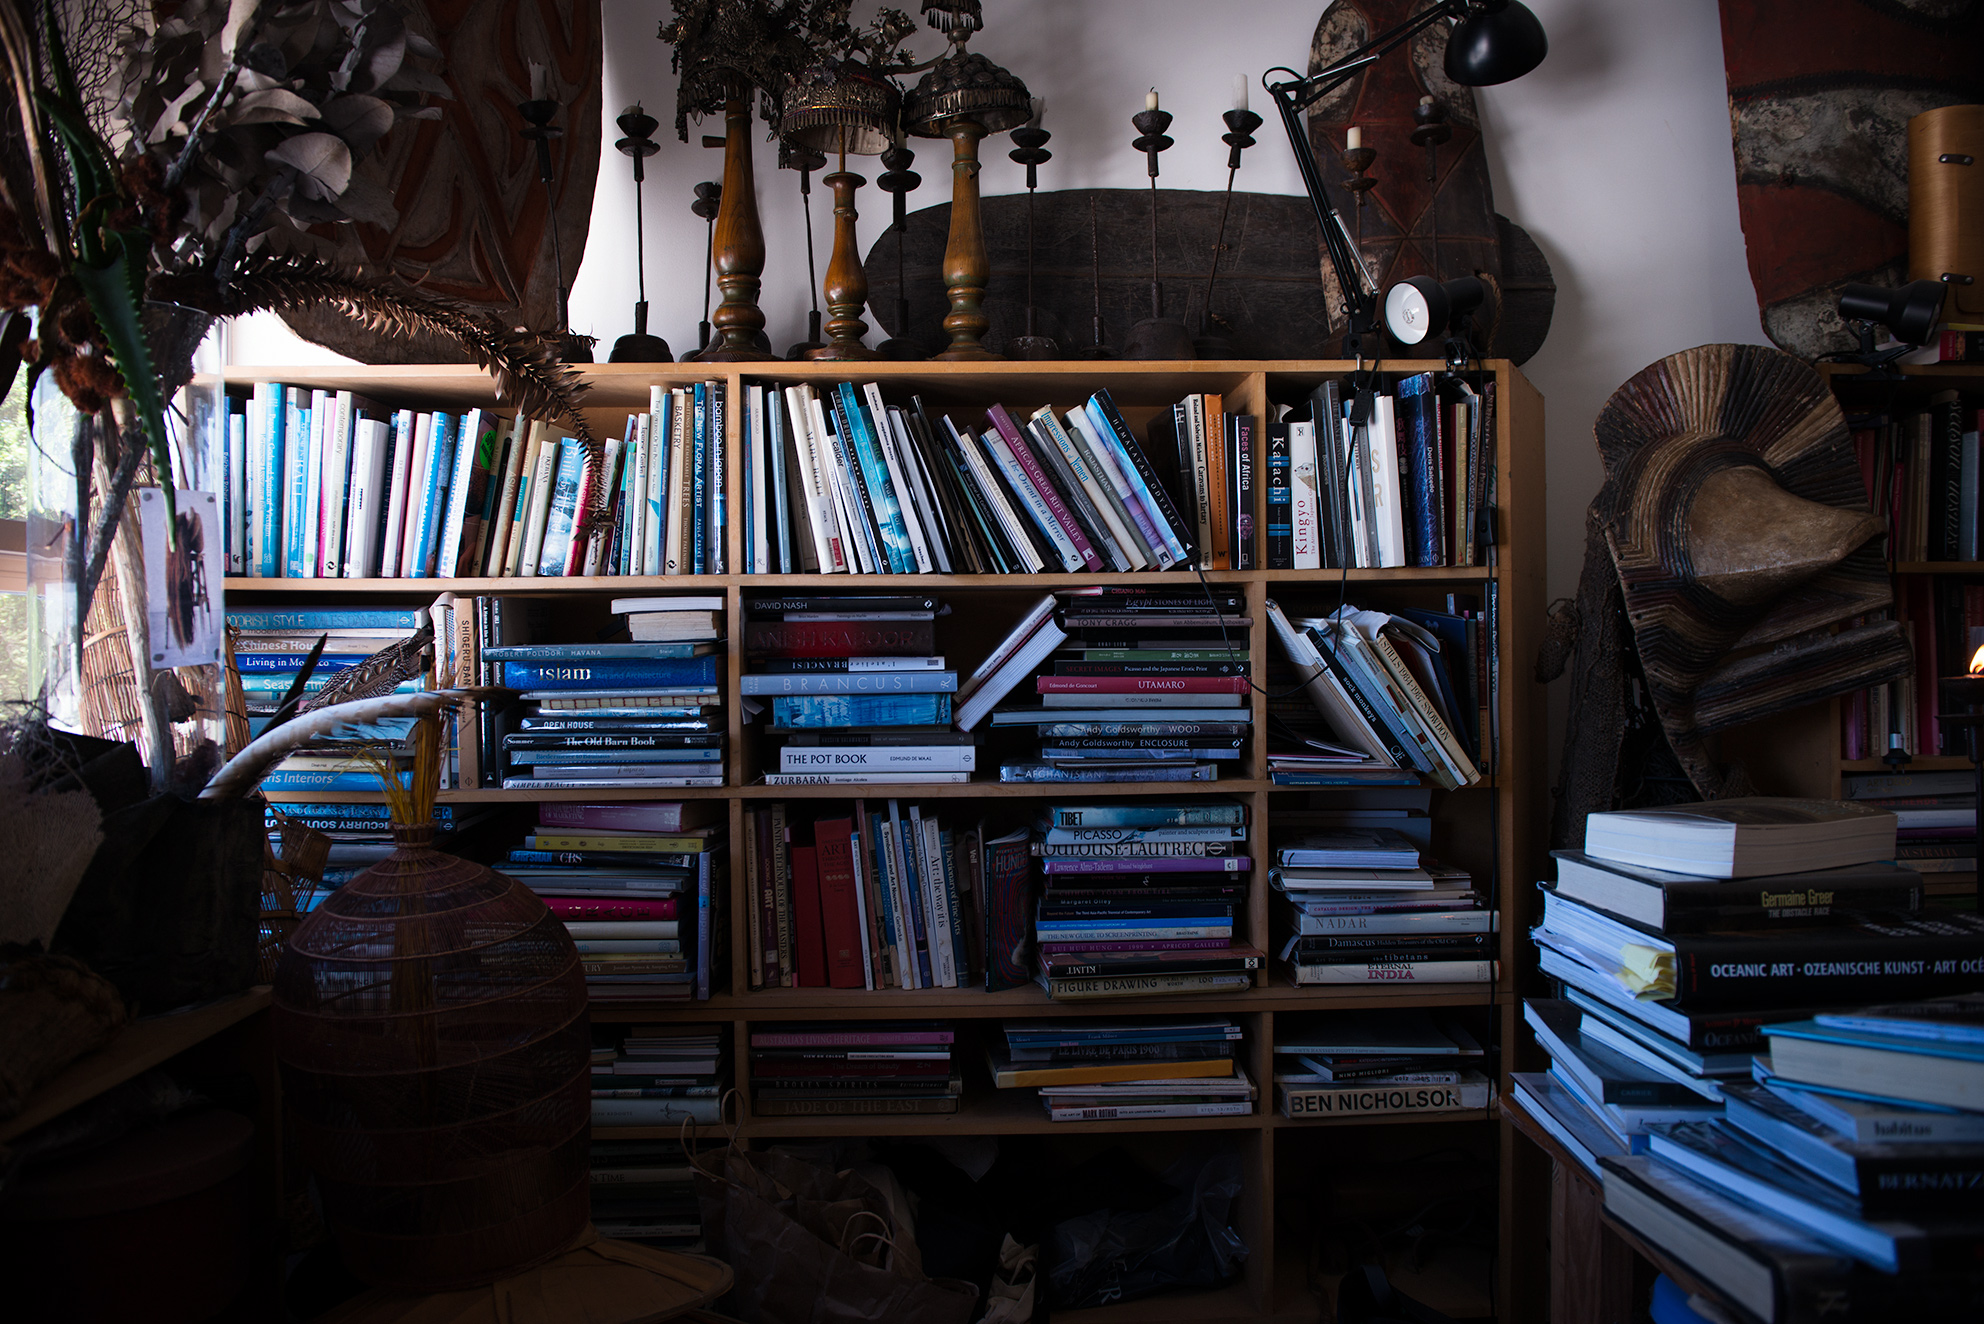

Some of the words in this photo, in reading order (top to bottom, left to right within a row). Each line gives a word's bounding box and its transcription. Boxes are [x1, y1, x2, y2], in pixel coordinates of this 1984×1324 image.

[674, 405, 682, 449] BASKETRY
[1241, 426, 1250, 451] Faces
[696, 442, 704, 475] FLORAL
[831, 440, 845, 467] calder
[1241, 453, 1250, 462] of
[1082, 447, 1112, 492] RAJASTHAN
[1111, 416, 1150, 478] HIMALAYAN
[1148, 481, 1180, 529] ODYSSEY
[1271, 436, 1286, 502] Katachi
[1320, 454, 1330, 485] Boundaries
[1197, 465, 1206, 494] Caravans
[1241, 464, 1250, 490] Africa
[682, 480, 691, 508] TREES
[1008, 434, 1037, 472] AFRICA'S
[1031, 468, 1054, 496] GREAT
[1048, 494, 1065, 515] RIFT
[1059, 512, 1084, 543] VALLEY
[1006, 456, 1022, 474] The
[1015, 471, 1039, 500] Orient
[1033, 498, 1044, 508] in
[1039, 507, 1047, 515] a
[1043, 513, 1068, 543] Mirror
[1198, 501, 1208, 525] Tartary
[1295, 500, 1311, 556] Kingyo
[754, 602, 781, 610] DAVID
[783, 602, 808, 610] NASH
[461, 620, 470, 661] SHIGERU
[752, 631, 816, 648] ANISH
[821, 630, 914, 647] KAPOOR
[539, 664, 591, 681] islam
[792, 661, 848, 669] BRANCUSI
[462, 666, 471, 685] BAN
[784, 677, 914, 690] BRANCUSI
[1138, 680, 1185, 689] UTAMARO
[1378, 639, 1403, 669] STILLS
[1397, 666, 1426, 703] 1984-1987
[1419, 701, 1451, 741] SNOWDON
[1340, 675, 1357, 693] sock
[1351, 691, 1380, 723] monkeys
[544, 721, 566, 729] OPEN
[567, 721, 594, 729] HOUSE
[1081, 726, 1103, 735] Andy
[1105, 725, 1160, 735] Goldsworthy
[1168, 725, 1201, 734] WOOD
[565, 736, 583, 746] The
[584, 736, 603, 746] Old
[605, 736, 629, 746] Barn
[630, 736, 656, 746] Book
[1059, 739, 1080, 748] Andy
[1082, 739, 1135, 748] Goldsworthy
[1139, 739, 1189, 747] ENCLOSURE
[786, 754, 807, 764] THE
[811, 754, 832, 764] POT
[835, 754, 867, 764] BOOK
[774, 775, 830, 785] ZURBARÁN
[1024, 768, 1102, 779] AFGHANISTAN
[1060, 812, 1083, 826] TIBET
[1074, 830, 1122, 840] PICASSO
[822, 844, 848, 857] ART
[882, 831, 893, 863] Symbolism
[1037, 842, 1204, 856] TOULOUSE-LAUTREC
[1900, 848, 1959, 858] AUSTRALIA
[968, 849, 977, 864] Veil
[943, 849, 957, 890] Dictionary
[1054, 863, 1078, 872] Lawrence
[1080, 862, 1114, 871] Alma-Tadema
[890, 886, 899, 912] Nouveau
[949, 890, 958, 899] of
[1761, 891, 1806, 908] Germaine
[1808, 888, 1835, 905] Greer
[950, 899, 960, 918] Fine
[1768, 908, 1781, 919] THE
[1782, 908, 1812, 918] OBSTACLE
[1814, 907, 1830, 917] RACE
[700, 910, 708, 941] japan
[894, 915, 903, 941] Gerhardus
[952, 918, 962, 935] Arts
[1315, 918, 1368, 929] NADAR
[1067, 965, 1096, 975] KLIMT
[1368, 970, 1414, 980] INDIA
[1710, 963, 1768, 978] OCEANIC
[1769, 963, 1795, 977] ART
[1803, 961, 1881, 976] OZEANISCHE
[1884, 960, 1925, 975] KUNST
[1933, 960, 1957, 974] ART
[1057, 980, 1099, 993] FIGURE
[1104, 978, 1157, 990] DRAWING
[759, 1035, 805, 1045] AUSTRALIA'S
[806, 1035, 832, 1045] LIVING
[833, 1035, 870, 1044] HERITAGE
[1058, 1047, 1070, 1055] LE
[1072, 1046, 1097, 1055] LIVRE
[1099, 1046, 1110, 1055] DE
[1113, 1046, 1138, 1055] PARIS
[1140, 1045, 1160, 1055] 1900
[1338, 1071, 1356, 1079] NINO
[783, 1101, 822, 1114] JADE
[825, 1100, 844, 1113] OF
[852, 1100, 882, 1112] THE
[887, 1100, 922, 1112] EAST
[1291, 1095, 1331, 1113] BEN
[1339, 1090, 1459, 1110] NICHOLSON
[1082, 1110, 1098, 1118] MARK
[1099, 1108, 1117, 1117] ROTHKO
[1874, 1122, 1932, 1136] habitus
[600, 1174, 626, 1183] TIME
